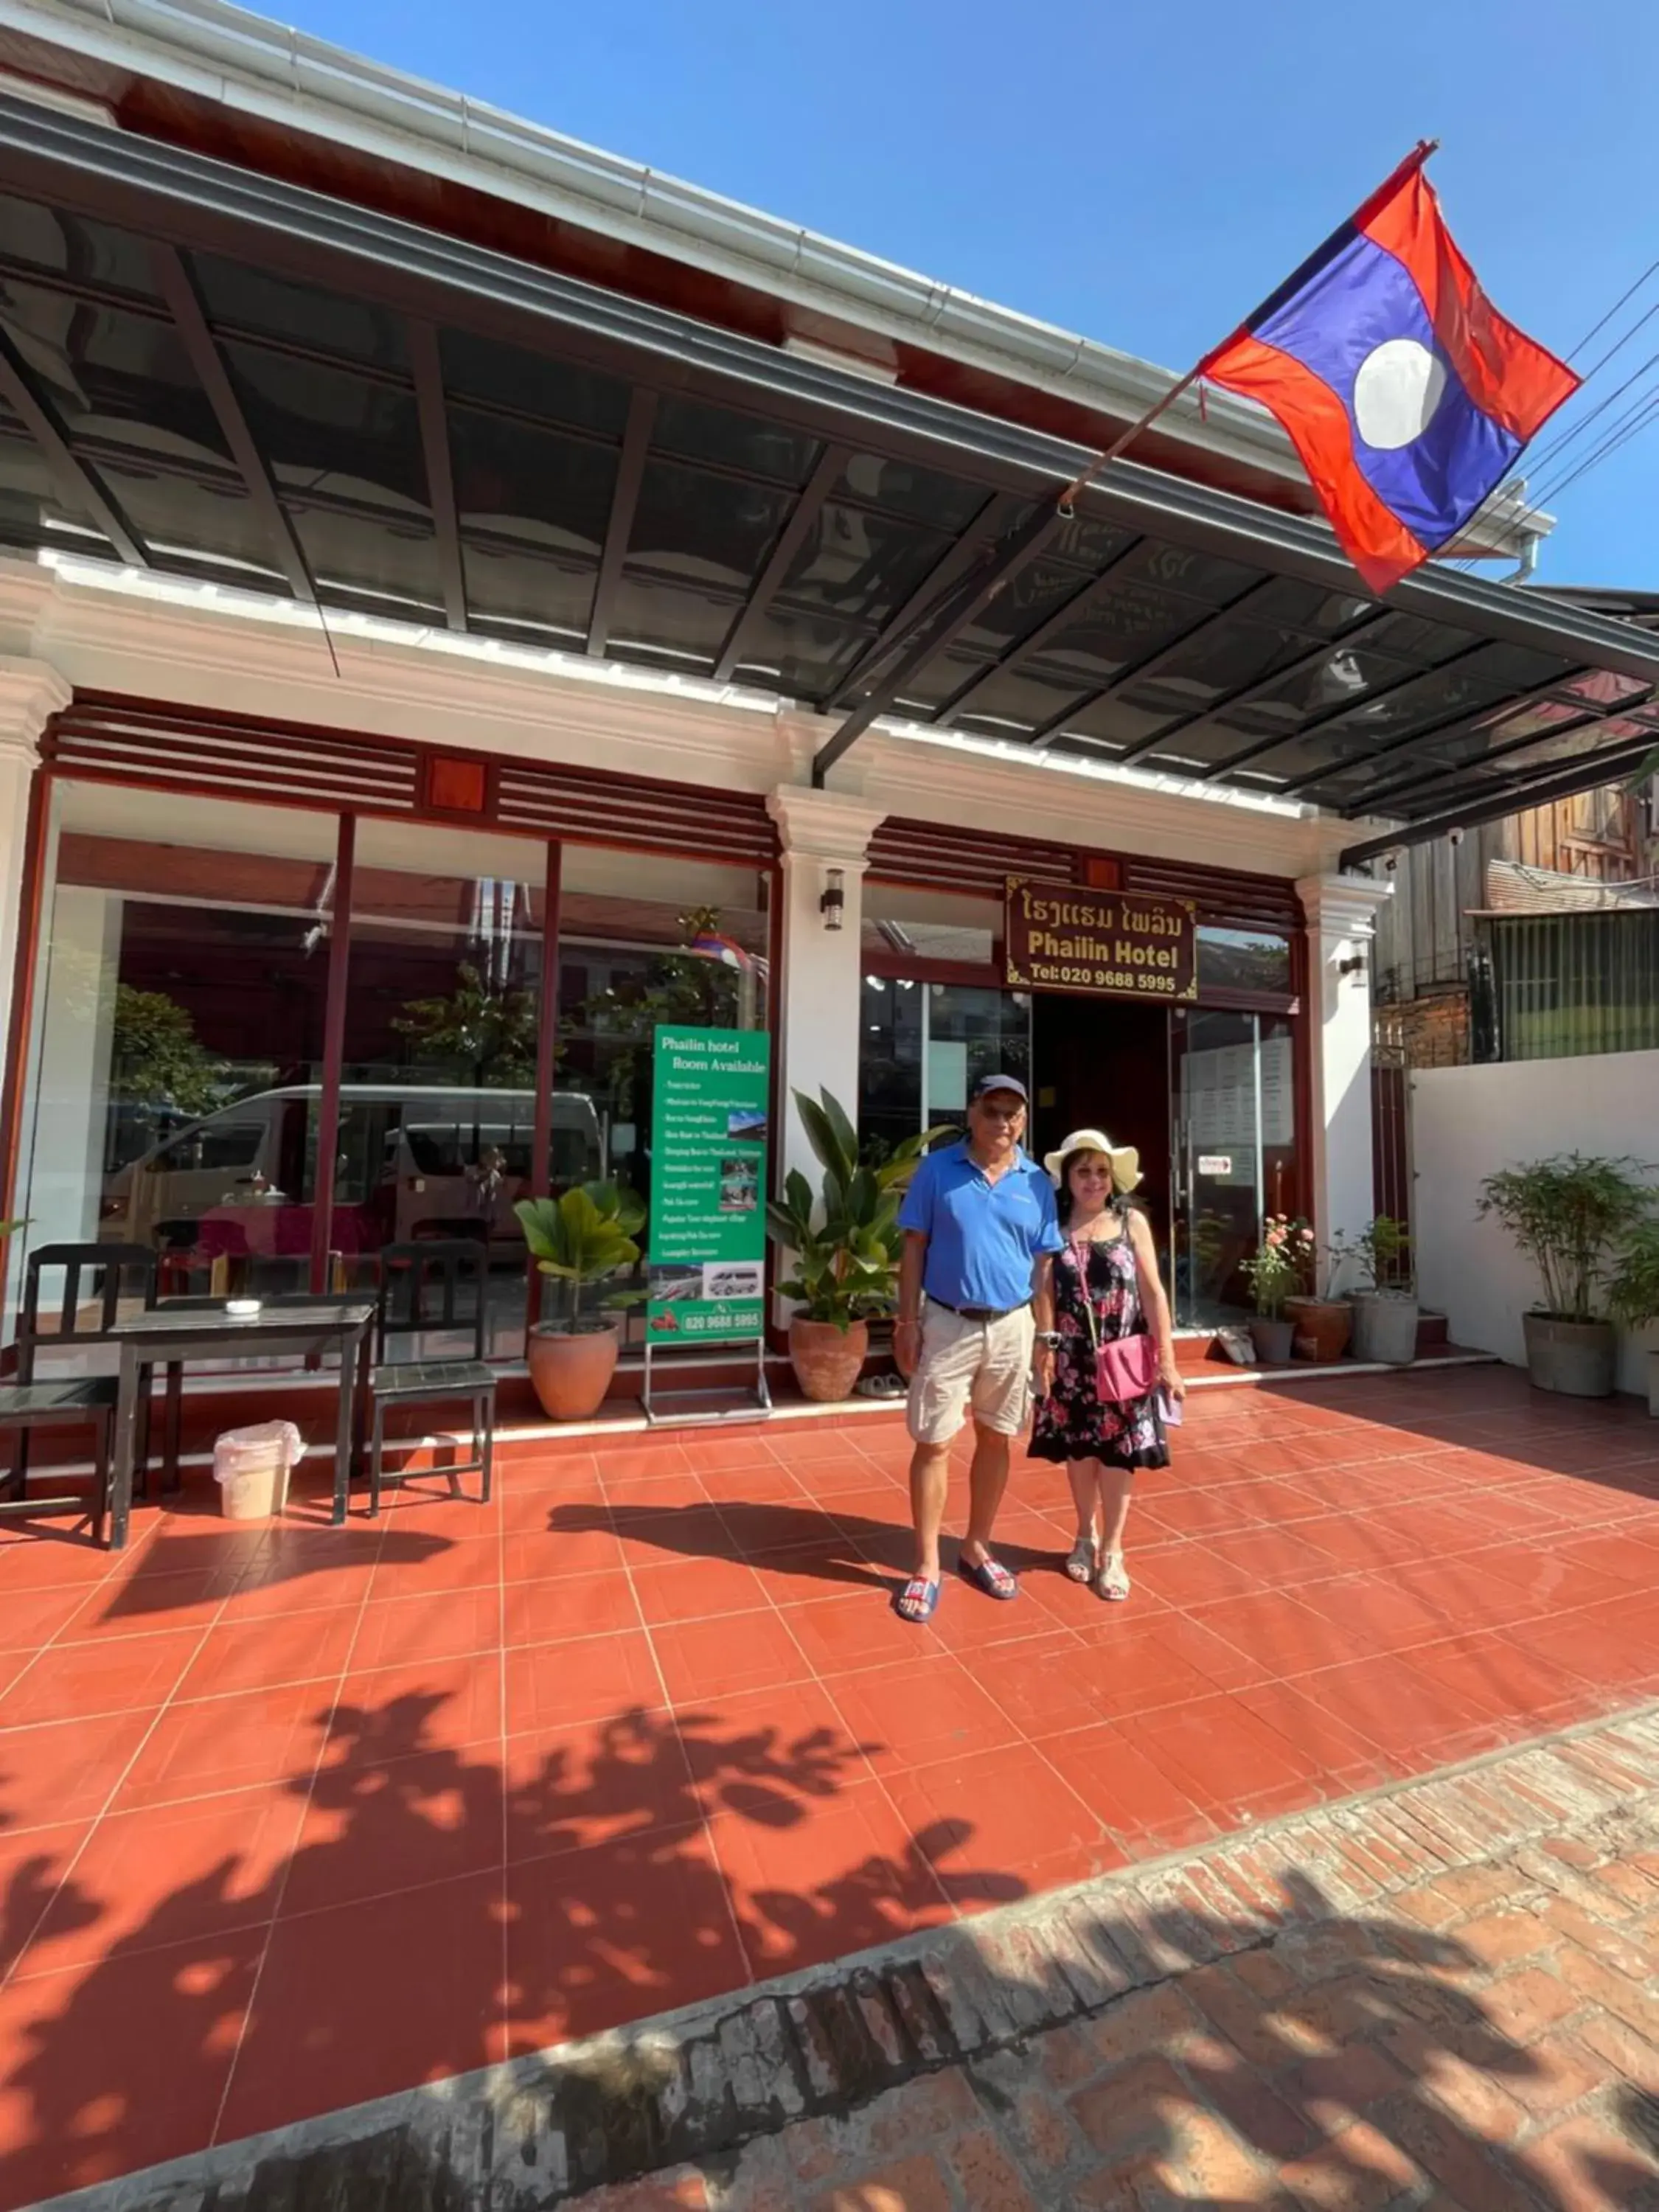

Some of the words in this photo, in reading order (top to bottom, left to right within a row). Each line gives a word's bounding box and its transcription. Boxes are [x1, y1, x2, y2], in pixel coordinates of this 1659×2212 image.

[1028, 931, 1109, 961] Phailin
[1115, 939, 1178, 968] Hotel
[1095, 970, 1133, 987] 9688
[1138, 974, 1175, 991] 5995
[662, 1037, 706, 1051] Phailin
[708, 1039, 740, 1053] hotel
[672, 1057, 709, 1071] Room
[711, 1059, 766, 1074] Available
